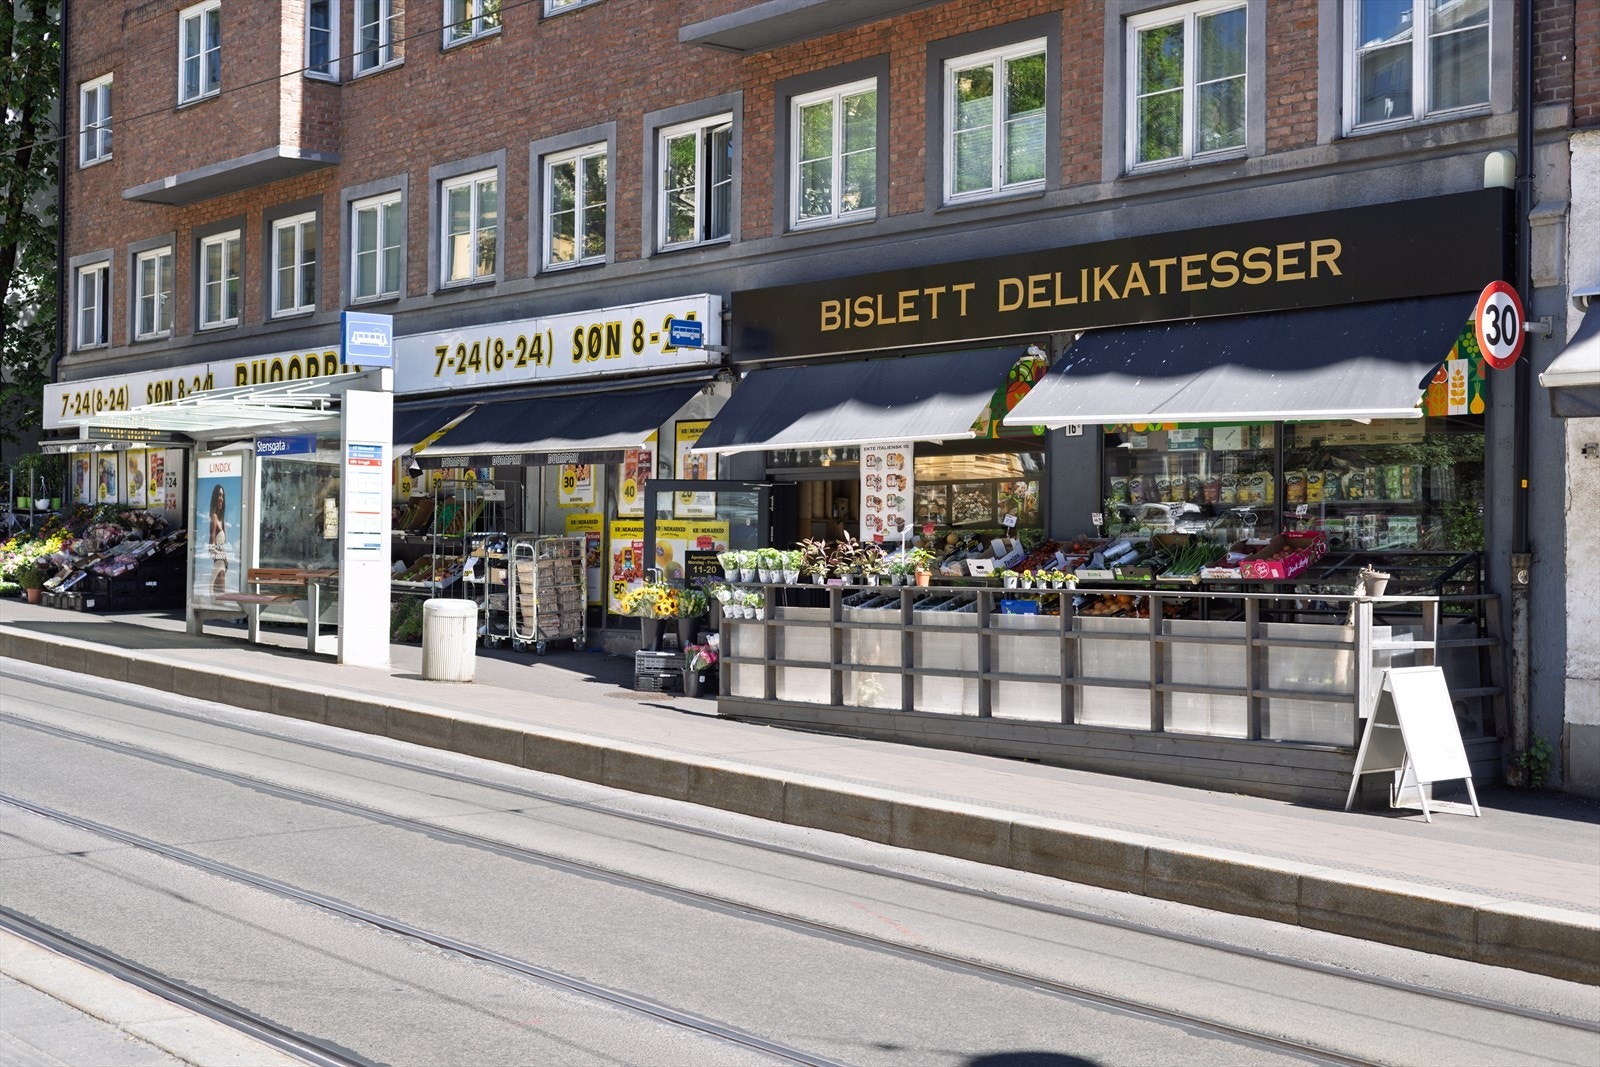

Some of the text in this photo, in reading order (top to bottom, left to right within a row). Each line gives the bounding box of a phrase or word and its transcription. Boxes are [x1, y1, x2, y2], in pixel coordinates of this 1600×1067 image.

[820, 238, 1343, 332] BISLETT DELIKATESSER
[1485, 304, 1517, 346] 30
[434, 311, 697, 377] 7-24(8-24) SØN 8-2
[61, 383, 129, 417] 7-24(8-24)
[256, 441, 286, 454] Stensgata
[209, 462, 232, 473] LINDEX
[402, 482, 411, 493] 50
[563, 476, 575, 488] 30
[624, 485, 635, 498] 40
[693, 565, 717, 574] 11-20
